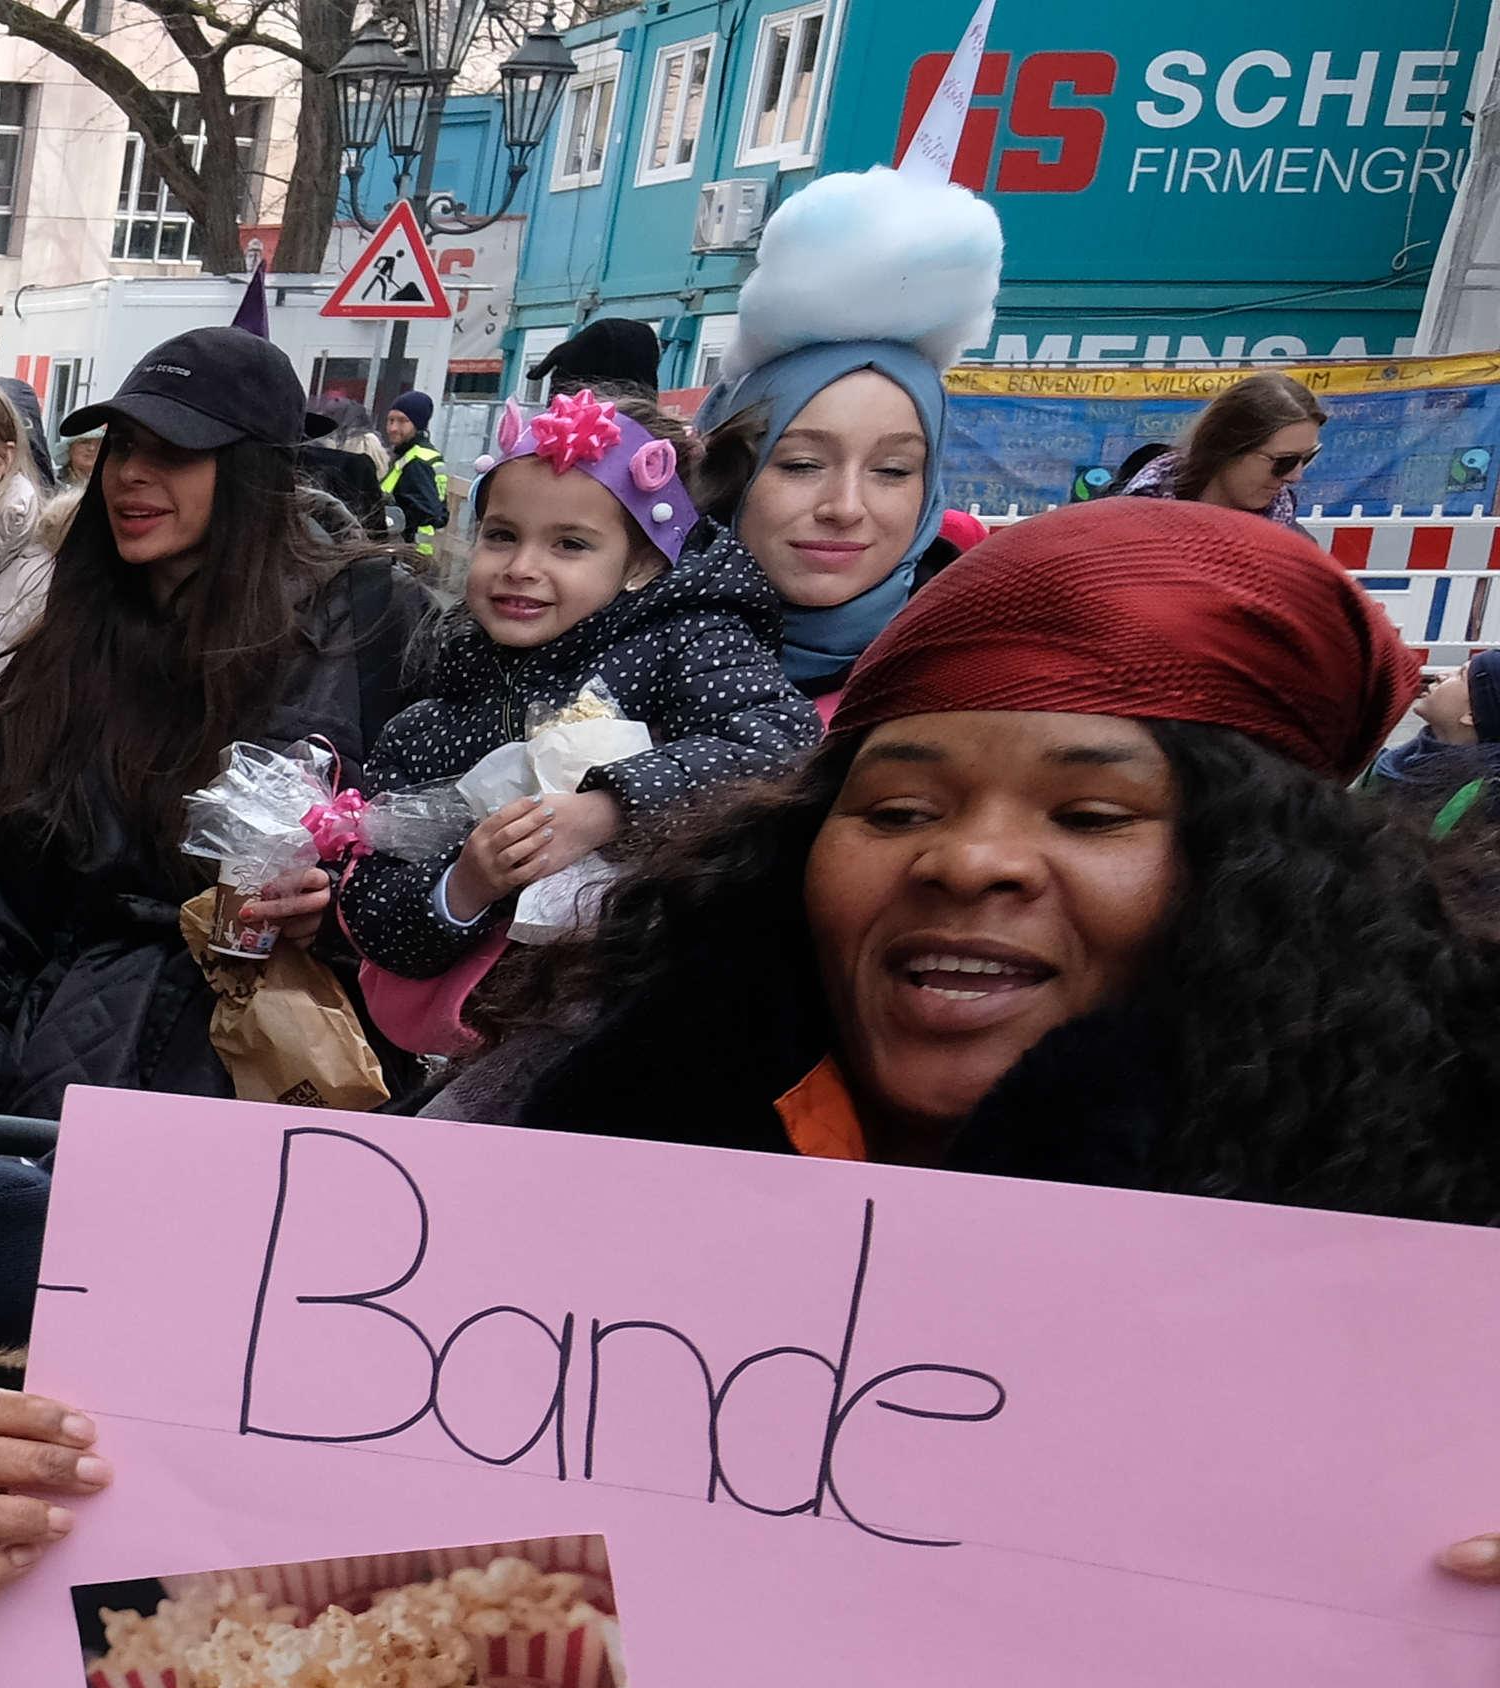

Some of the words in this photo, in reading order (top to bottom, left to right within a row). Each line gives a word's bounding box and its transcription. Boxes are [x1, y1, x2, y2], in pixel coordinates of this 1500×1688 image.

[1134, 49, 1483, 129] SCHE
[1007, 374, 1114, 394] BENVENUTO
[1305, 371, 1331, 389] IM
[239, 1126, 1007, 1548] Bande
